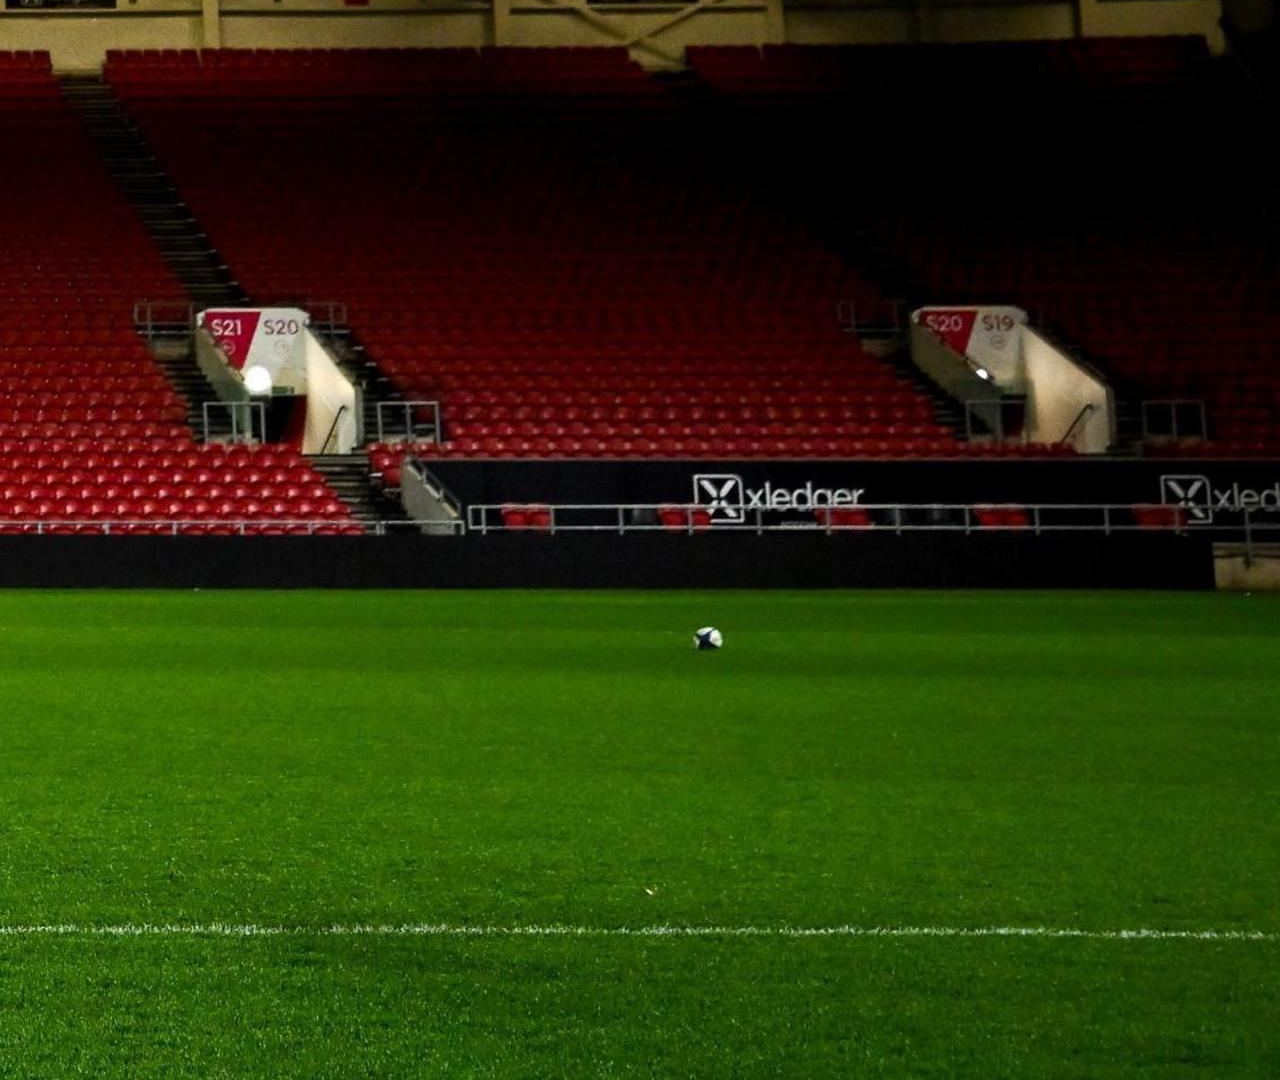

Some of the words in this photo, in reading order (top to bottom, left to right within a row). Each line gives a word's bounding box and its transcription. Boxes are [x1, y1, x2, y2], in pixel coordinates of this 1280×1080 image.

[211, 319, 242, 336] S21
[263, 319, 299, 335] S20
[983, 315, 1014, 332] S19
